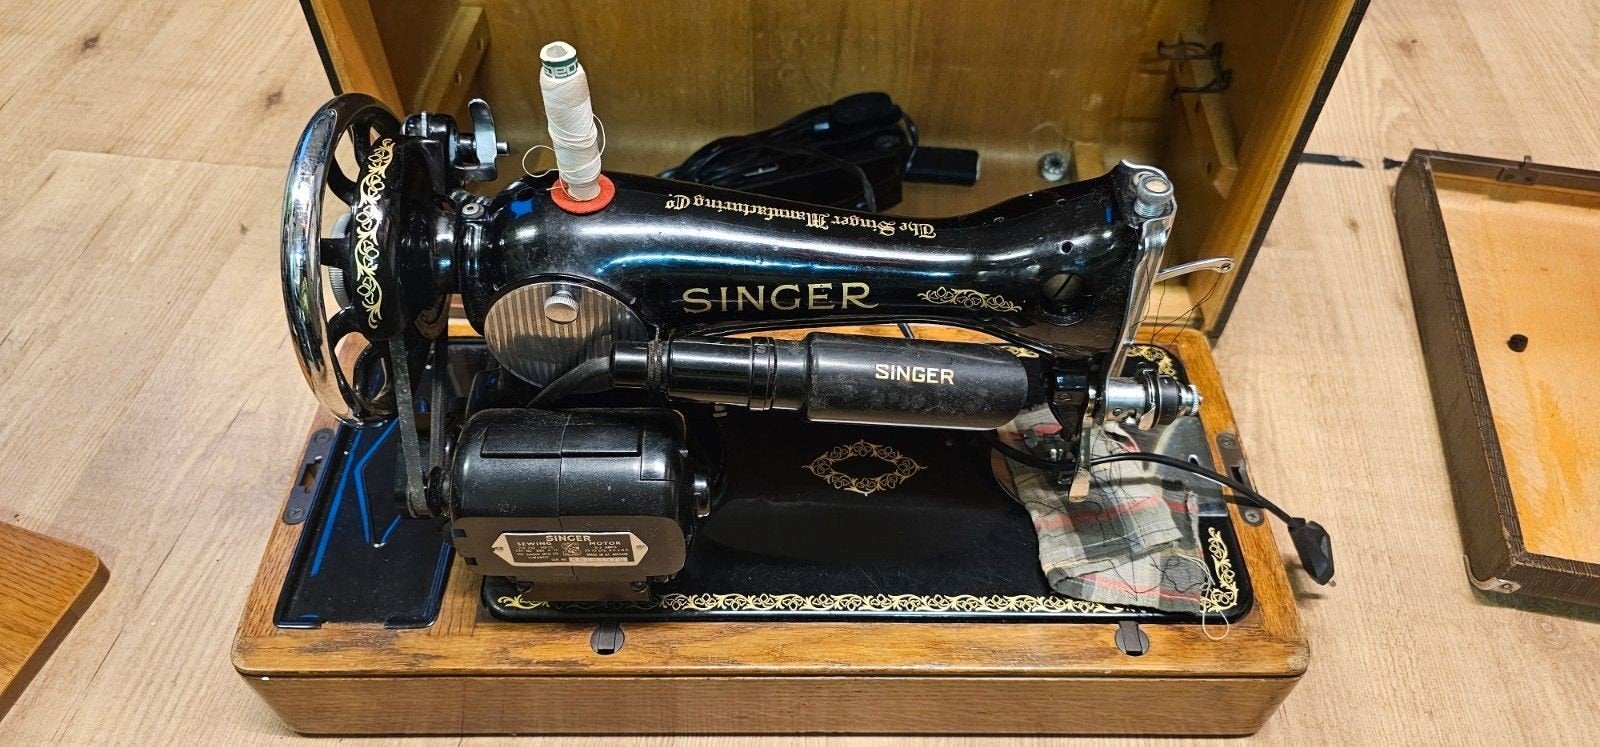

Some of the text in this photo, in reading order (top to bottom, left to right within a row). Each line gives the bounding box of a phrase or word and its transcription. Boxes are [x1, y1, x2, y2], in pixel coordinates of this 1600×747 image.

[693, 194, 831, 230] Manufacturing
[830, 213, 896, 236] Singer
[898, 221, 937, 239] The
[682, 282, 879, 314] SINGER
[875, 363, 955, 385] SINGER
